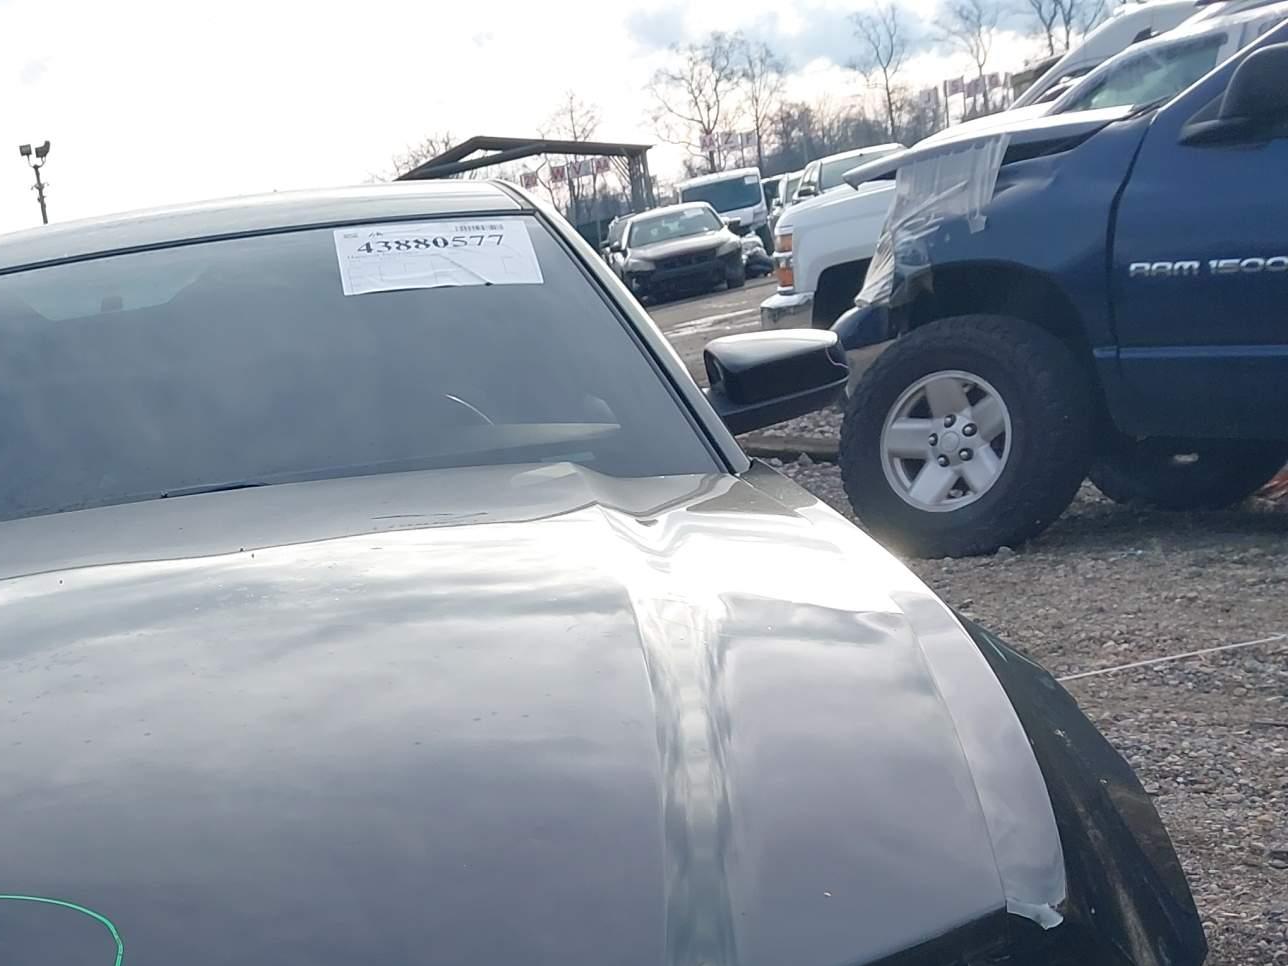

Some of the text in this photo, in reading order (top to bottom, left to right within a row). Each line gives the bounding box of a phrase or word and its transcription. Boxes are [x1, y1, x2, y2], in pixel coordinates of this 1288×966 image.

[357, 234, 505, 254] 43880577
[1129, 256, 1288, 277] RAM 1500
